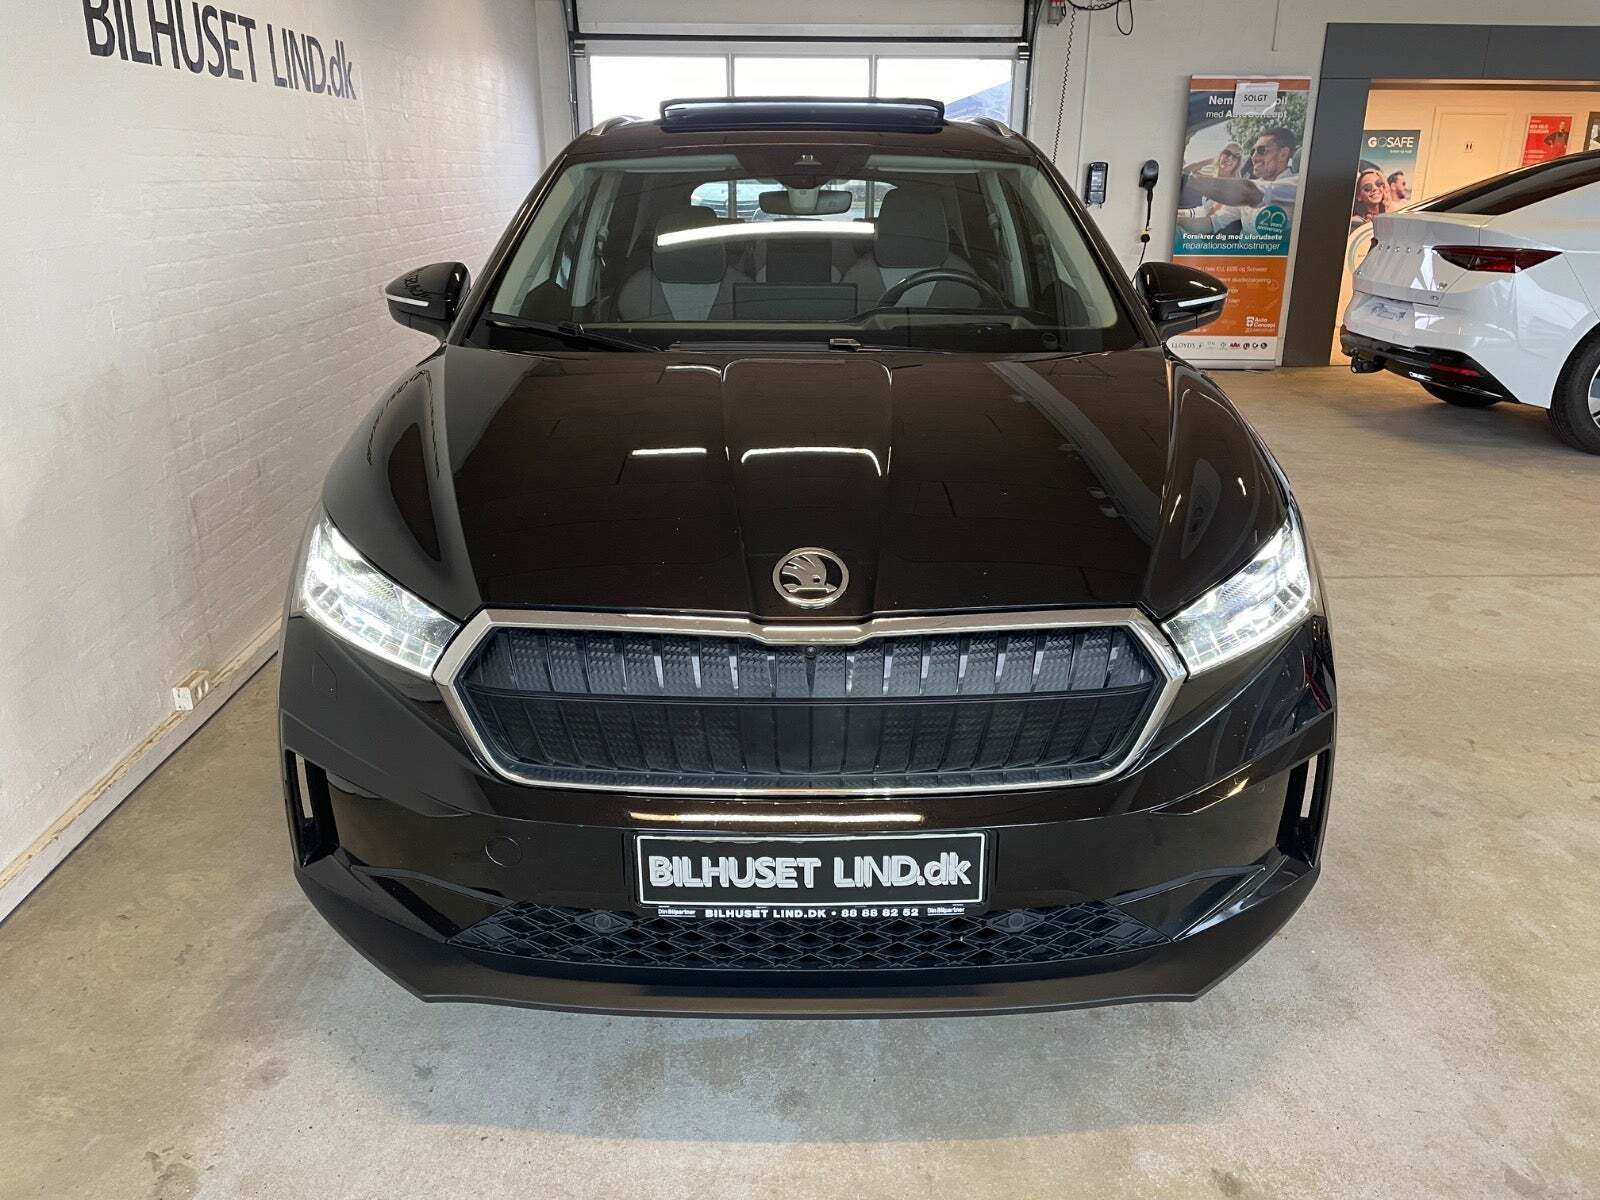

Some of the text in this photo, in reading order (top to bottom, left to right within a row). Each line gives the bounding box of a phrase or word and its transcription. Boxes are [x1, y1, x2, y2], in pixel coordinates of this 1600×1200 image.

[82, 0, 357, 100] BILHUSET LIND.dk
[1243, 94, 1268, 102] SOLGT
[1259, 209, 1286, 226] 20
[1215, 233, 1227, 241] dig
[1182, 240, 1281, 252] reparationsomkostninger
[648, 852, 973, 889] BILHUSET LIND.dk
[705, 909, 769, 918] BILHUSET
[772, 909, 827, 919] LIND.DK
[882, 908, 899, 917] 82
[902, 908, 919, 917] 52
